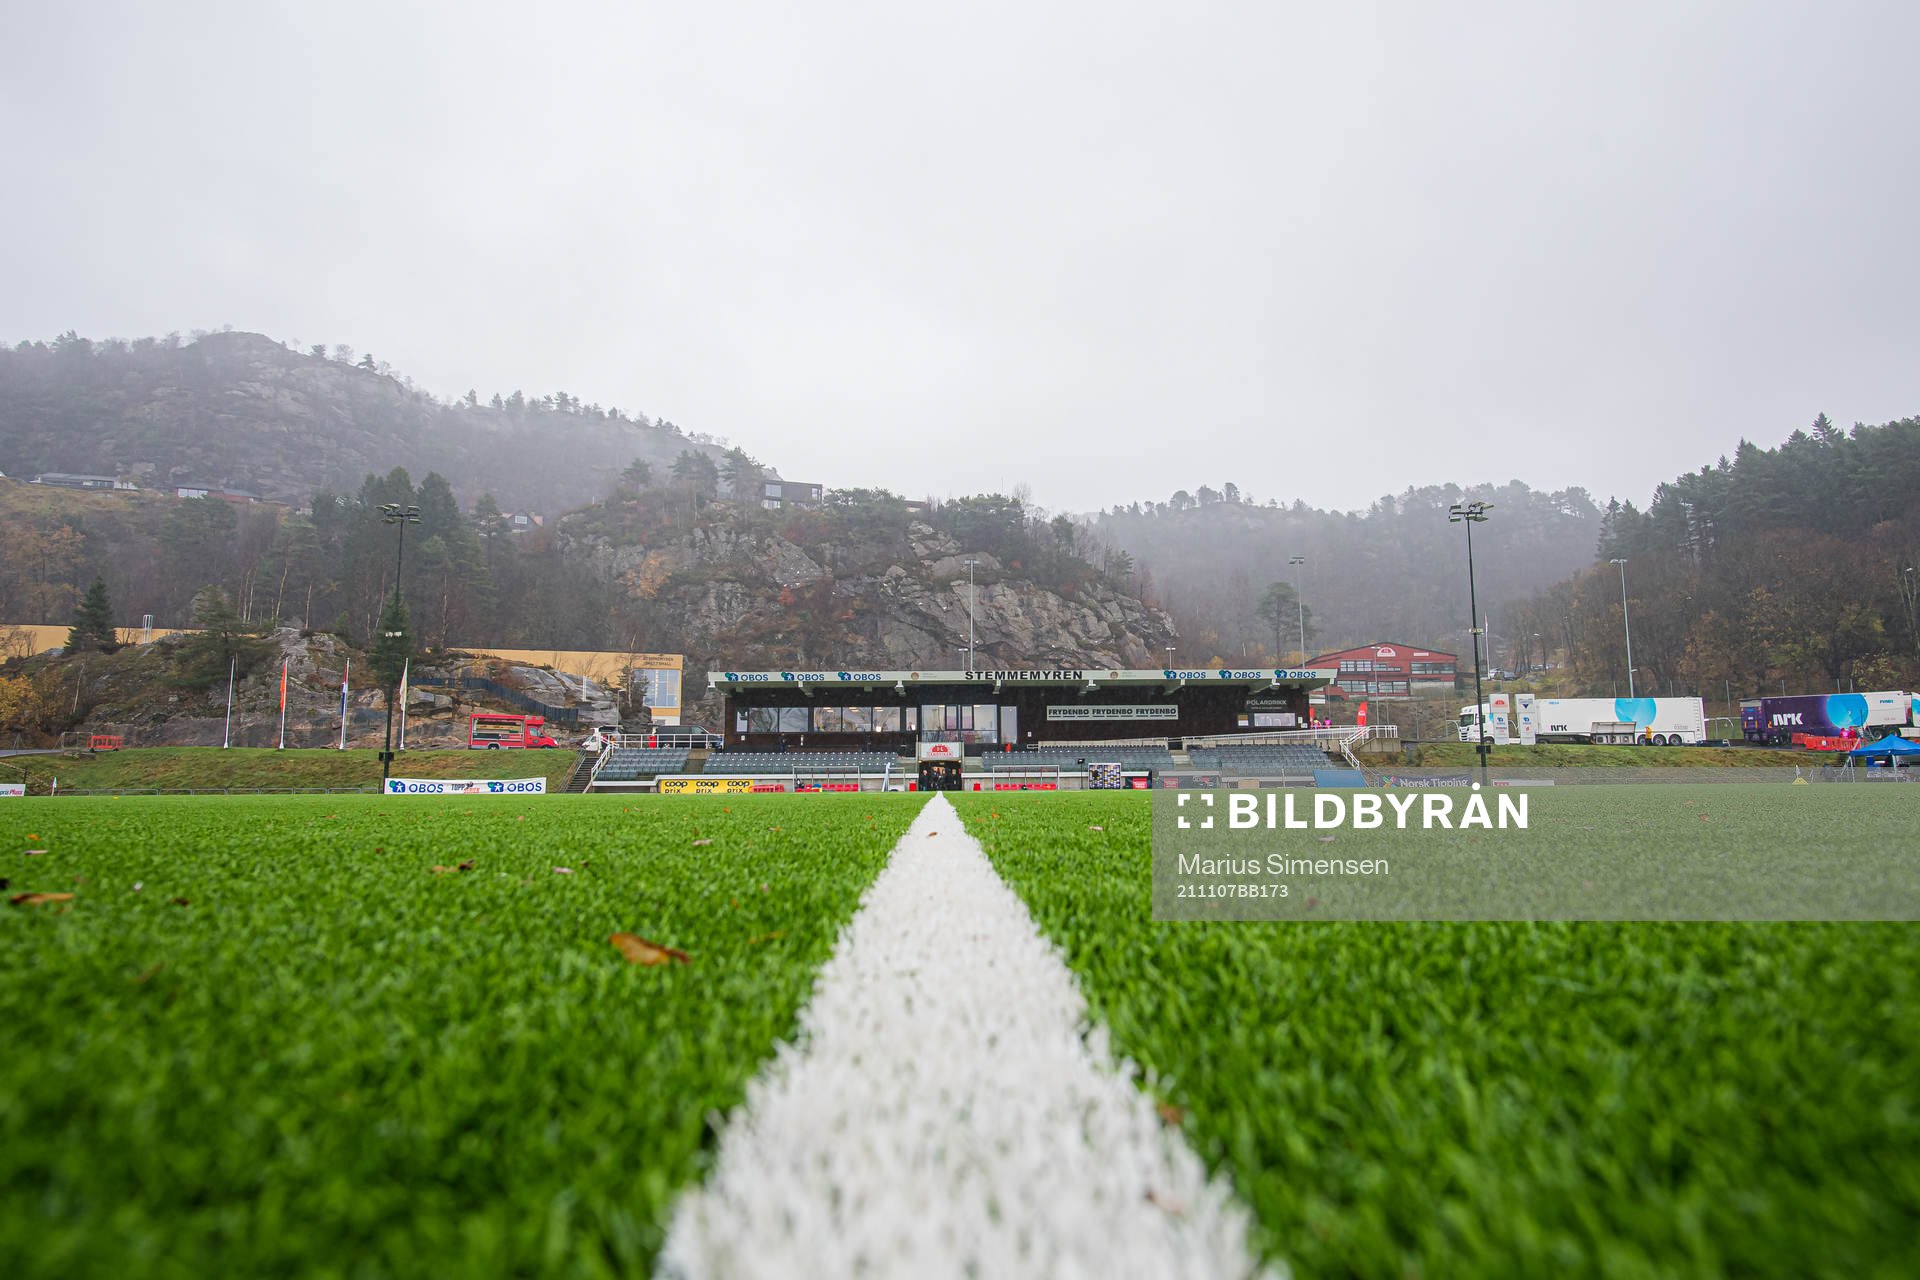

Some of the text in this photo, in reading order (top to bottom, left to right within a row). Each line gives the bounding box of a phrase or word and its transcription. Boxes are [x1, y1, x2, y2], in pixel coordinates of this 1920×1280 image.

[797, 673, 825, 681] OBOS
[853, 673, 881, 681] OBOS
[965, 671, 1083, 680] STEMMEMYREN
[1234, 671, 1261, 679] OBOS
[1289, 671, 1316, 679] OBOS
[506, 782, 542, 792] OBOS
[1400, 777, 1469, 788] Norsk Tipping
[408, 783, 444, 793] OBOS
